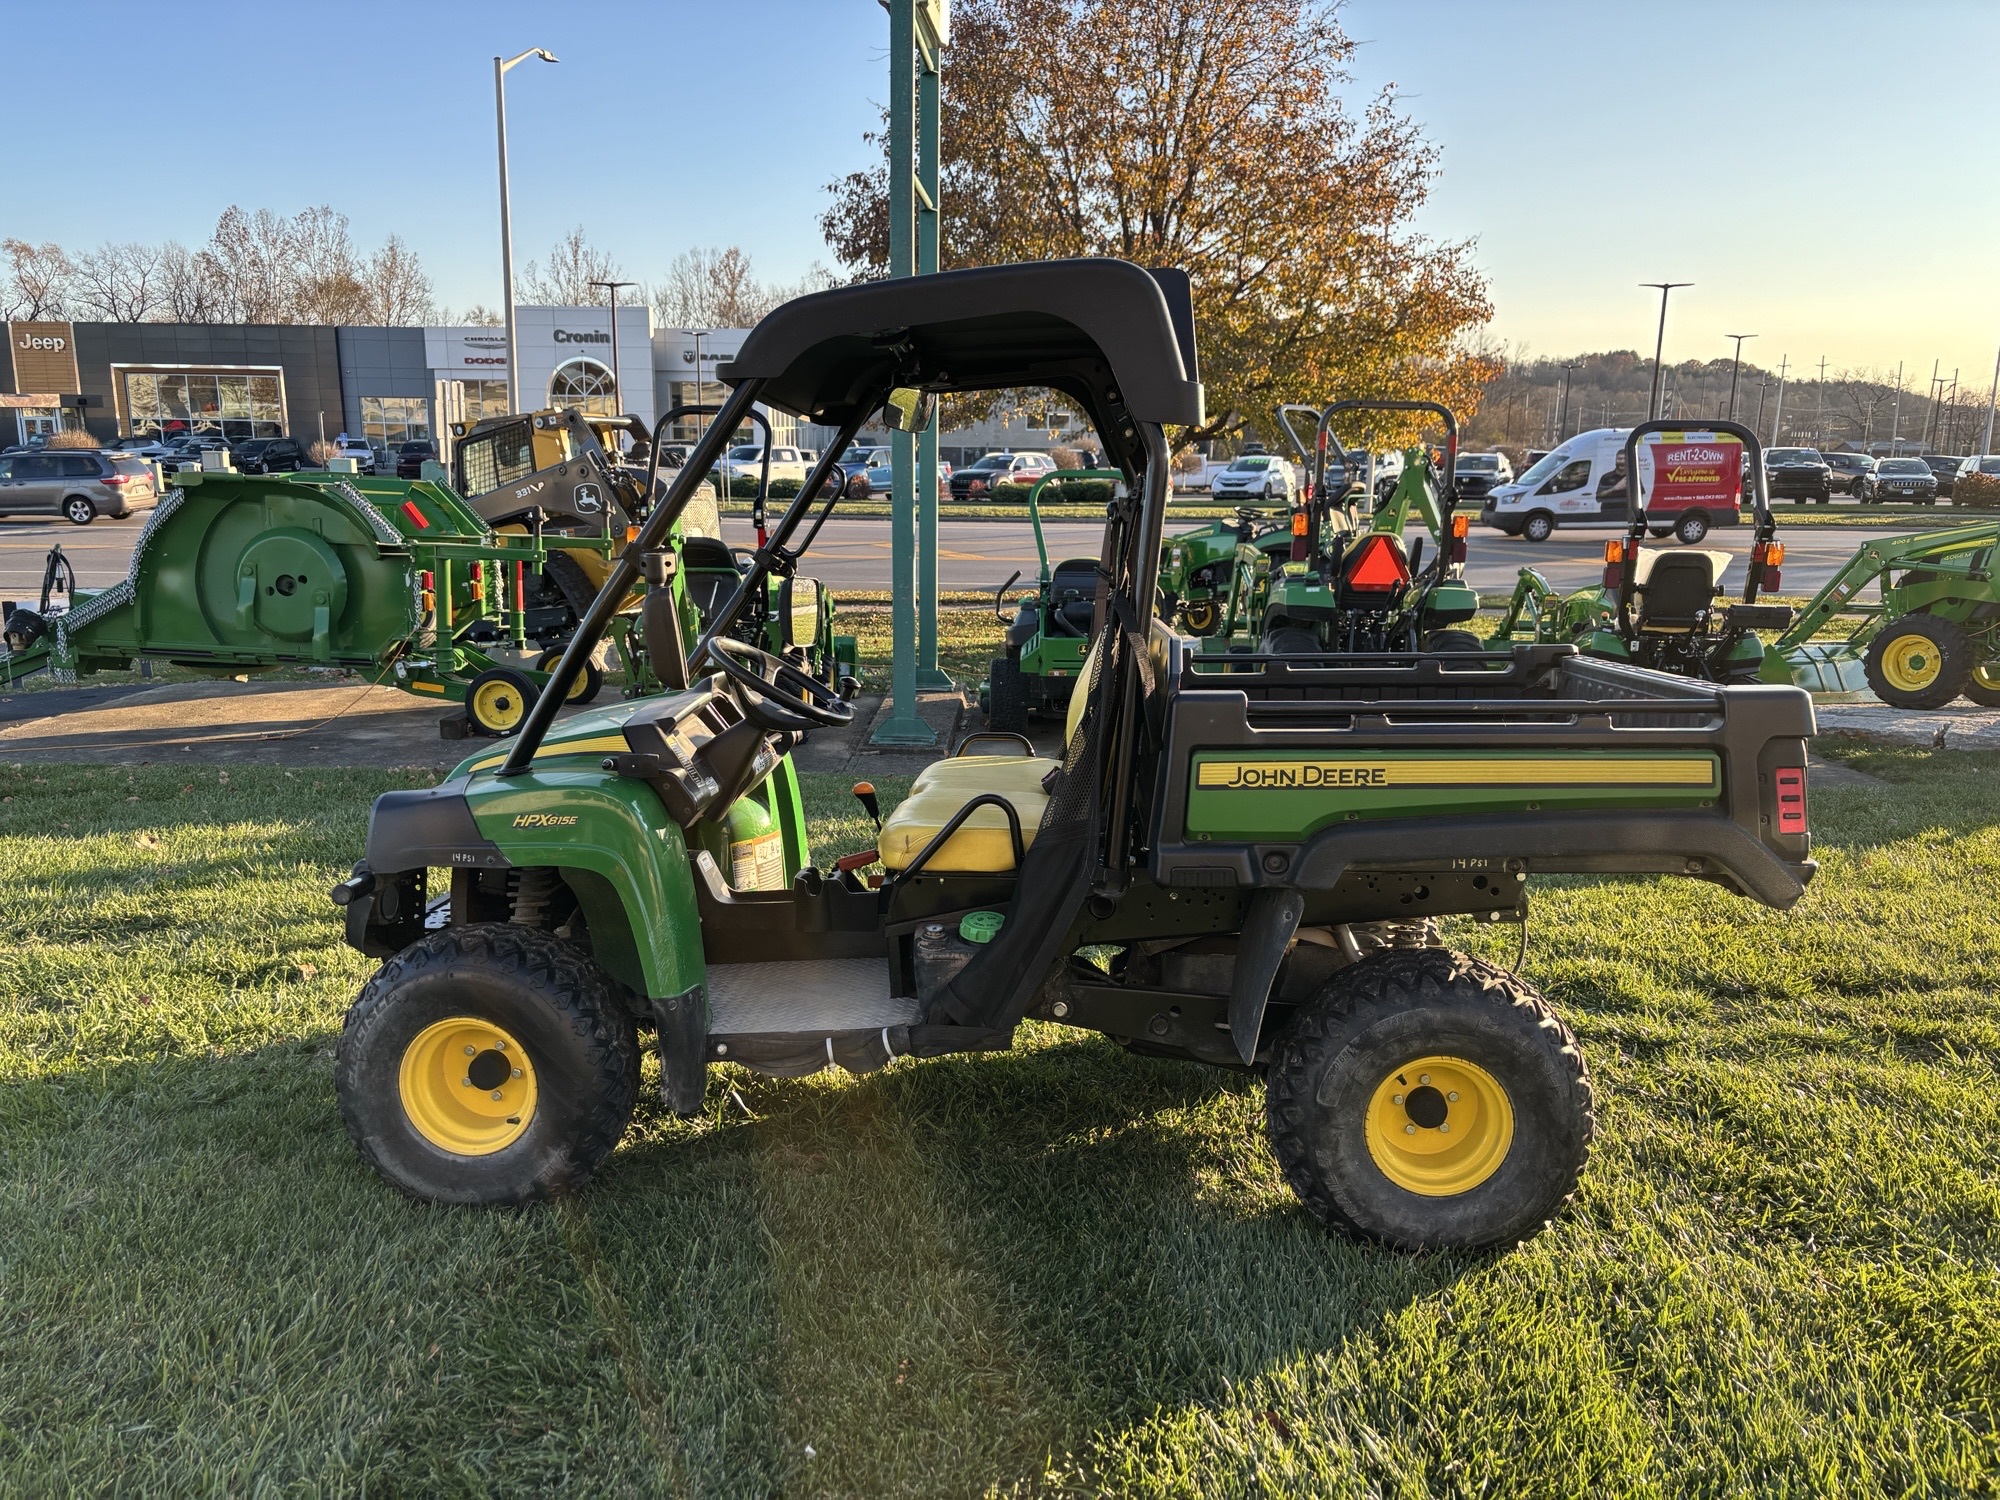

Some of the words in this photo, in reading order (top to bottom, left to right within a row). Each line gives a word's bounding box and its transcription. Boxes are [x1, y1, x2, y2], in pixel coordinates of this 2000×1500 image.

[19, 333, 66, 353] Jeep
[553, 329, 611, 344] Cronin
[464, 357, 507, 365] DODG
[1228, 765, 1297, 787] JOHN
[1302, 765, 1387, 786] DEERE
[452, 853, 461, 862] 14
[462, 853, 475, 863] PSI
[1452, 858, 1466, 869] 14
[1470, 858, 1488, 868] PSI
